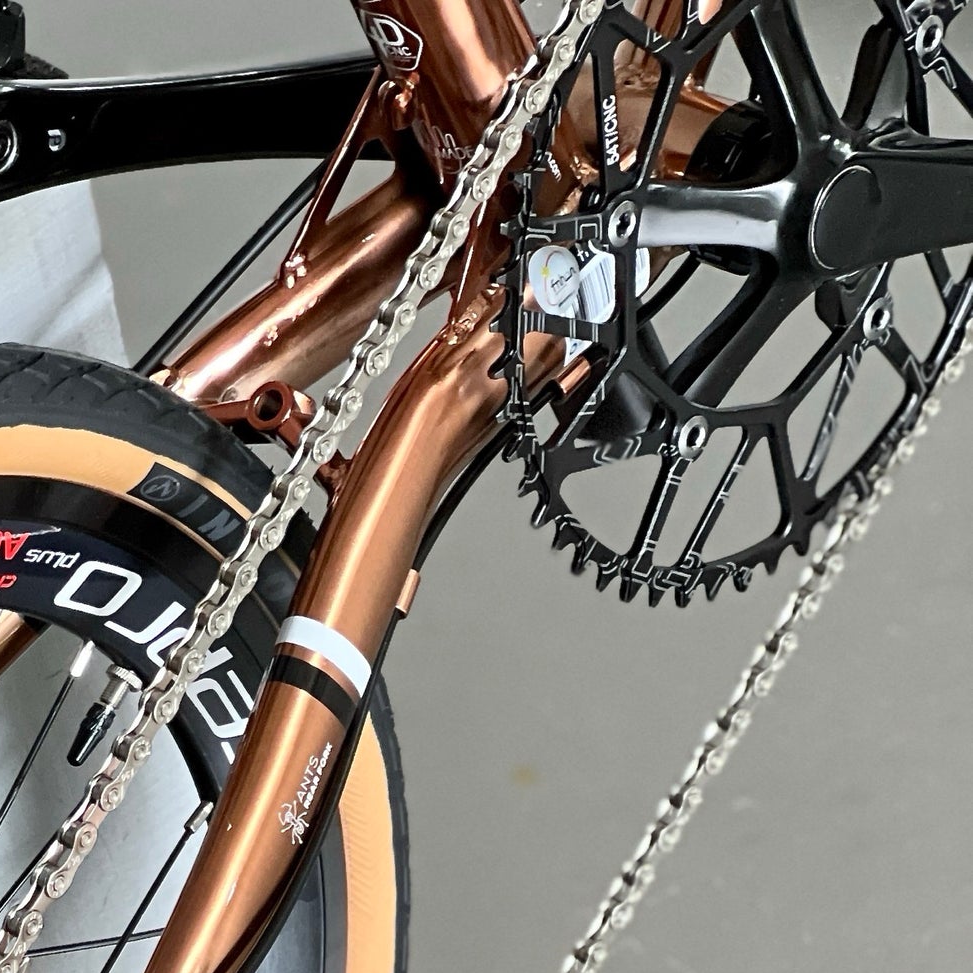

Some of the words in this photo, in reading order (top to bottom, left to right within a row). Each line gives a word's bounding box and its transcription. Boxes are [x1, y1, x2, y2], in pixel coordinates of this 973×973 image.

[24, 548, 80, 569] plus
[297, 755, 319, 803] ANTS
[303, 776, 320, 809] REAR
[316, 742, 333, 775] FORK
